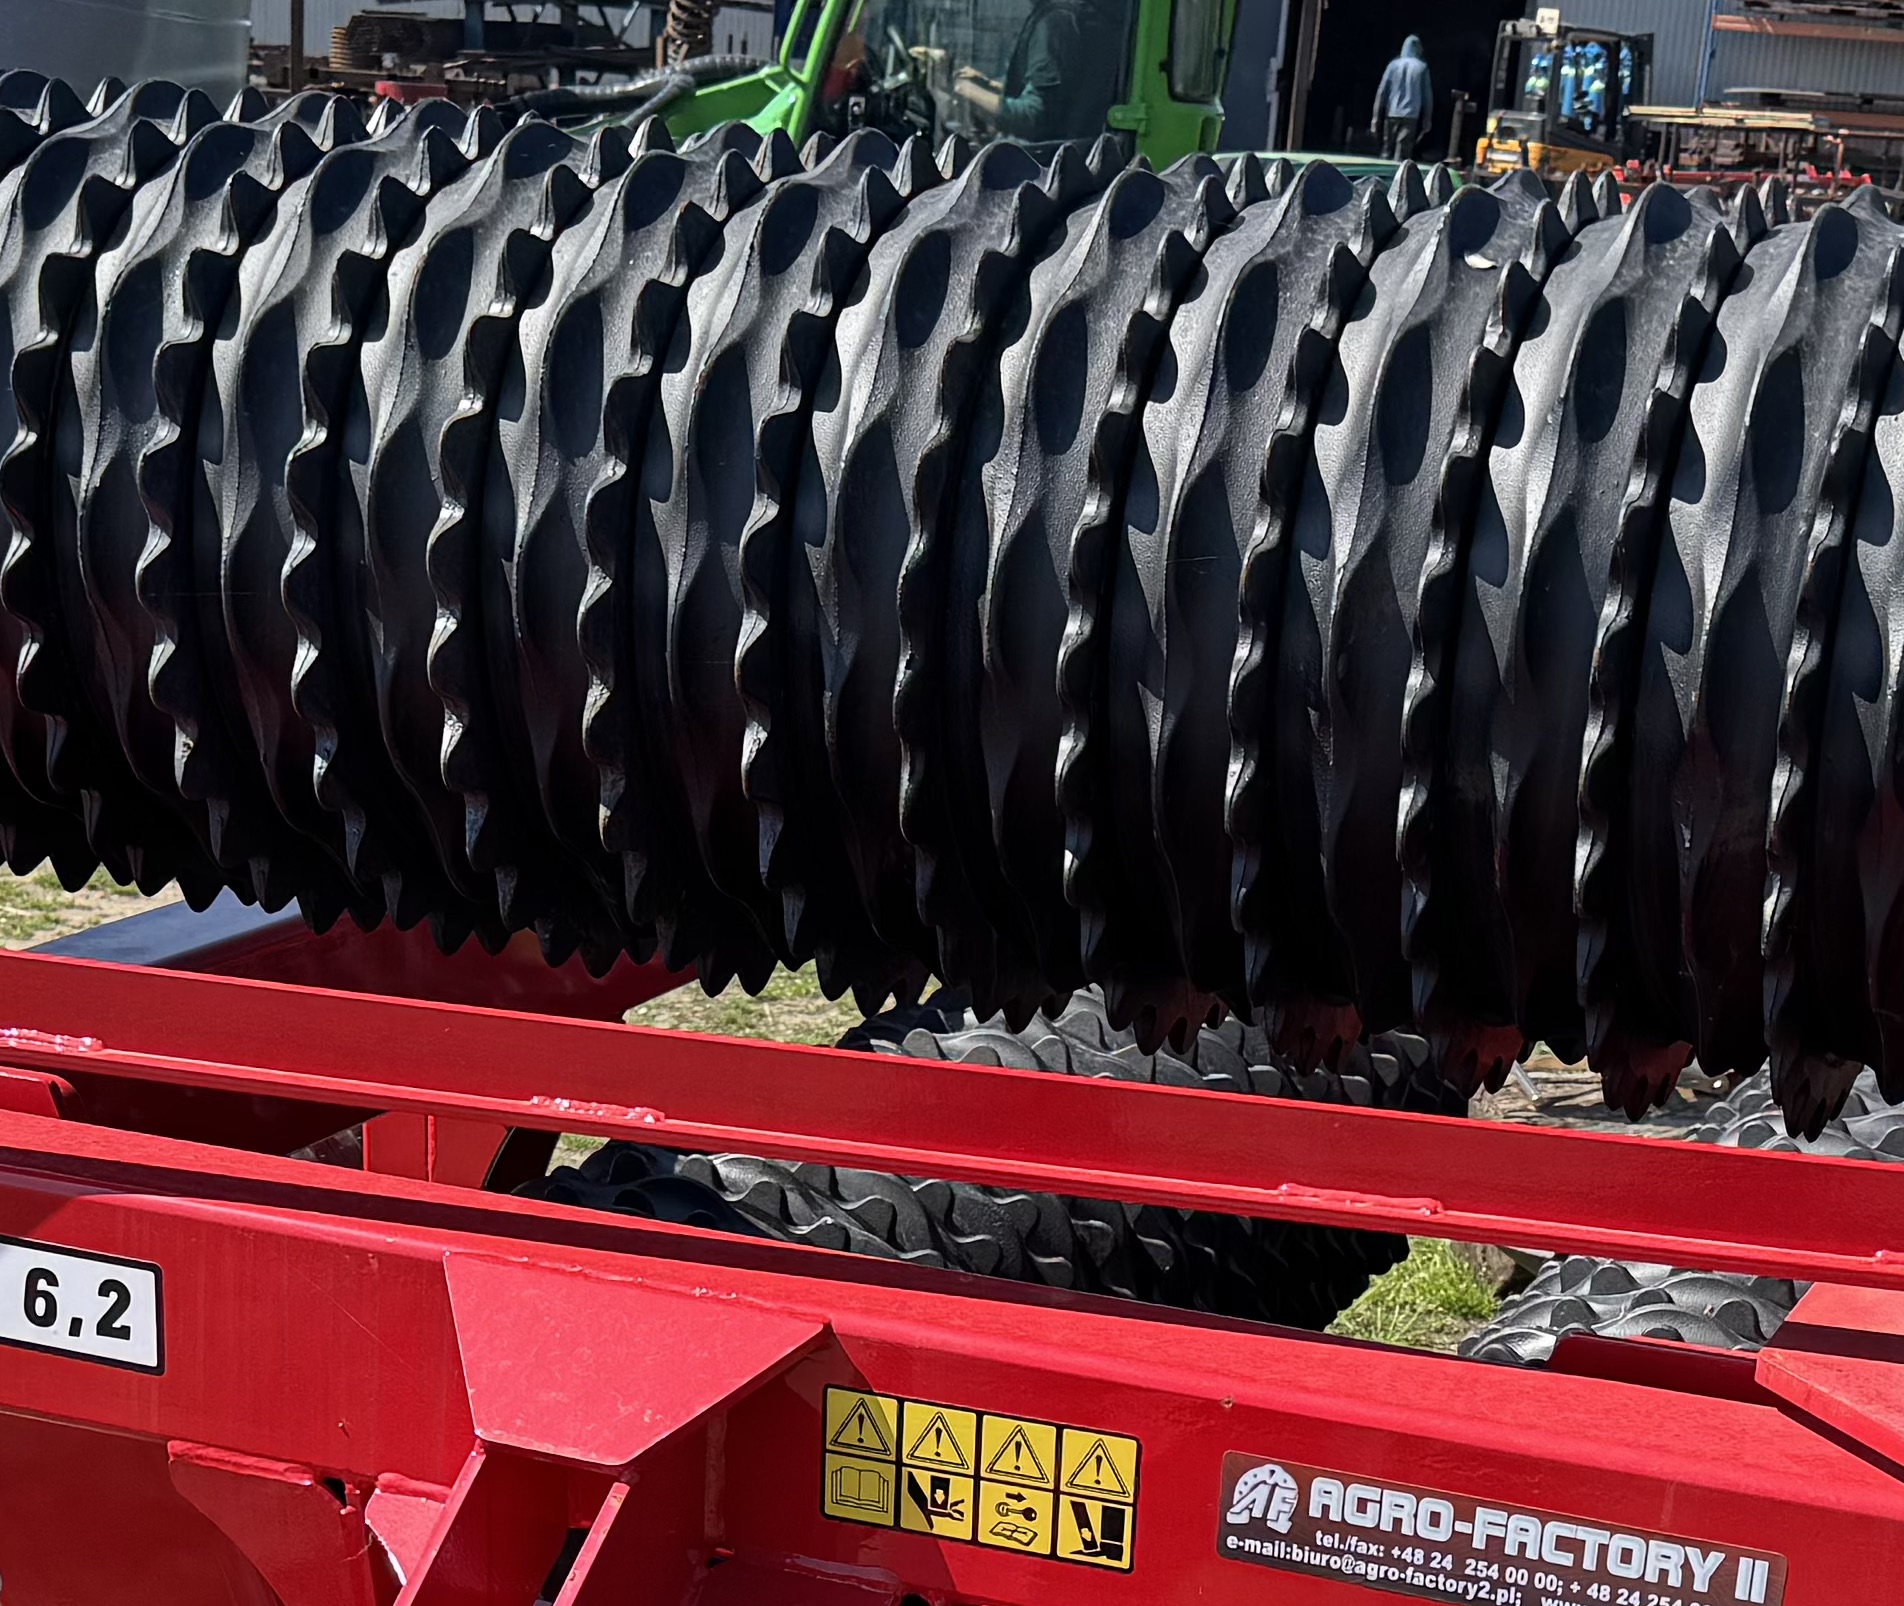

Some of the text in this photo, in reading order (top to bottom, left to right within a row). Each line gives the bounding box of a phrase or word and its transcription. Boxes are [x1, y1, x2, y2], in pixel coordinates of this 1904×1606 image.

[23, 1267, 132, 1341] 6,2
[1308, 1477, 1770, 1604] AGRO-FACTORY II
[1315, 1530, 1384, 1558] tel./fax:
[1391, 1545, 1425, 1566] +48
[1430, 1551, 1454, 1572] 24
[1464, 1558, 1499, 1581] 254
[1505, 1565, 1529, 1586] 00
[1533, 1571, 1564, 1594] 00;
[1587, 1582, 1612, 1602] 48
